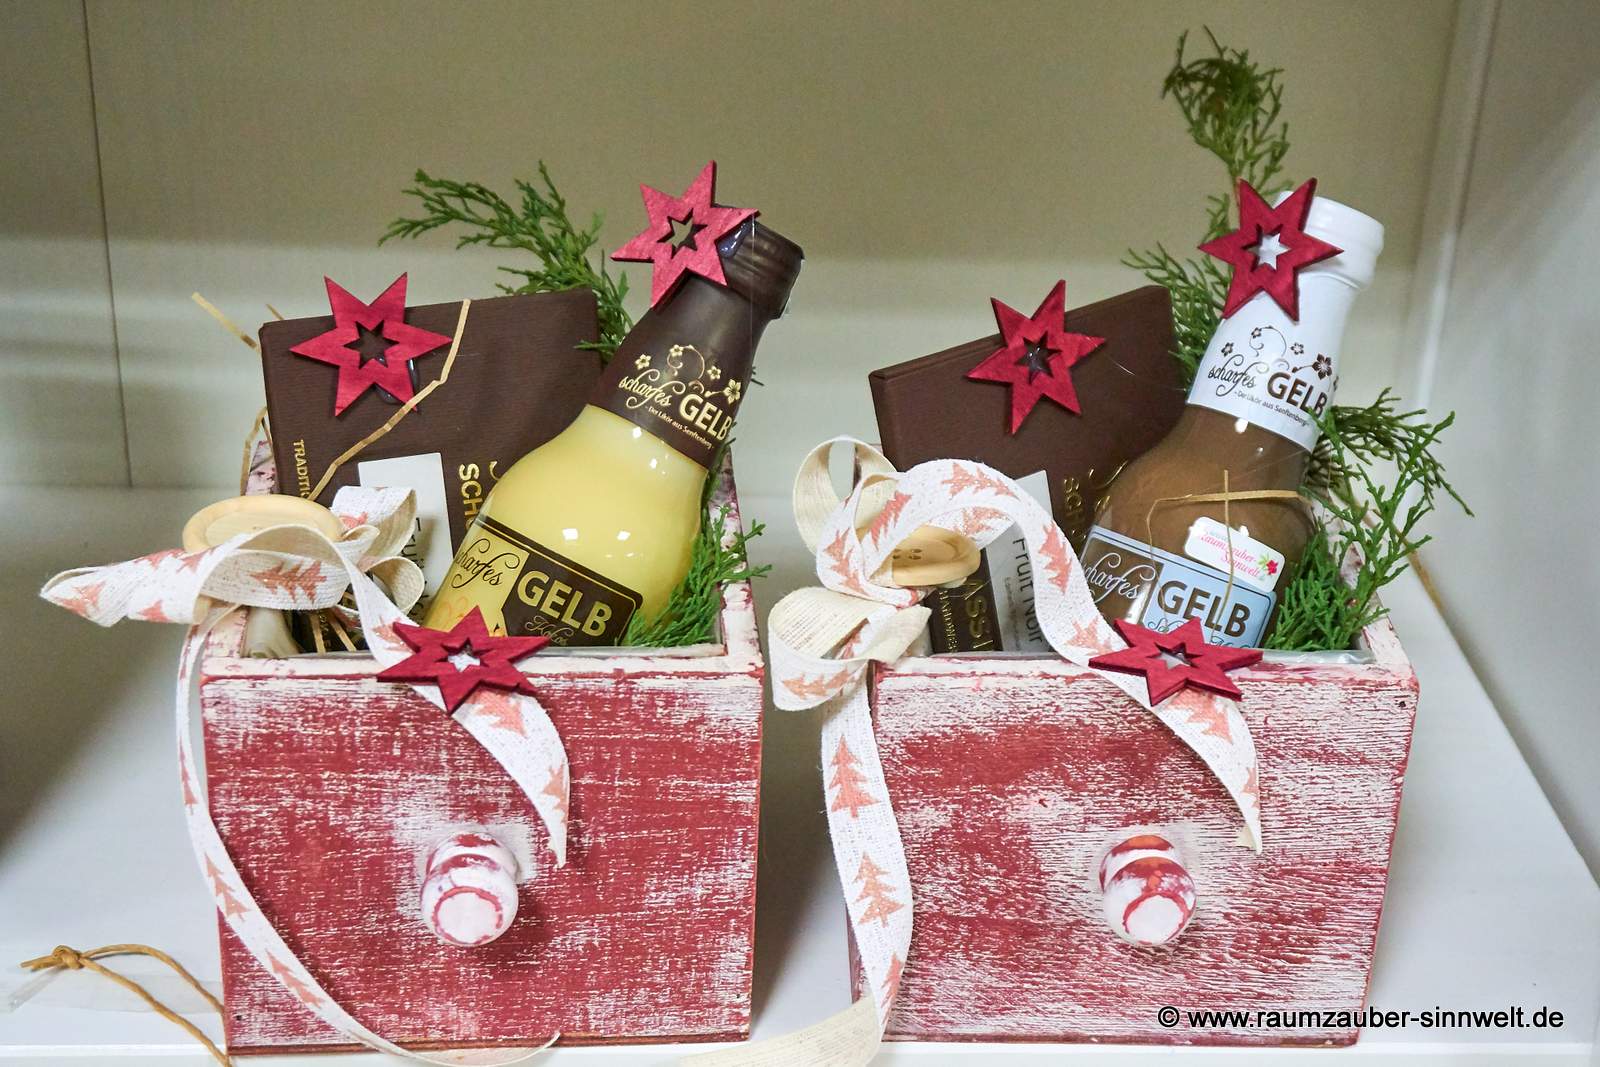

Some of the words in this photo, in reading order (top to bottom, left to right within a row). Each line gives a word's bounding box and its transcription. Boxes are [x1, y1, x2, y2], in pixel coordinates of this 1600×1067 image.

[619, 368, 686, 409] scharfes
[679, 393, 733, 441] GELB
[1208, 354, 1269, 397] scharfes
[1267, 372, 1328, 417] GELB
[451, 538, 520, 588] harfes
[517, 570, 613, 637] GELB
[1083, 552, 1156, 604] charfes
[1157, 580, 1252, 638] GELB
